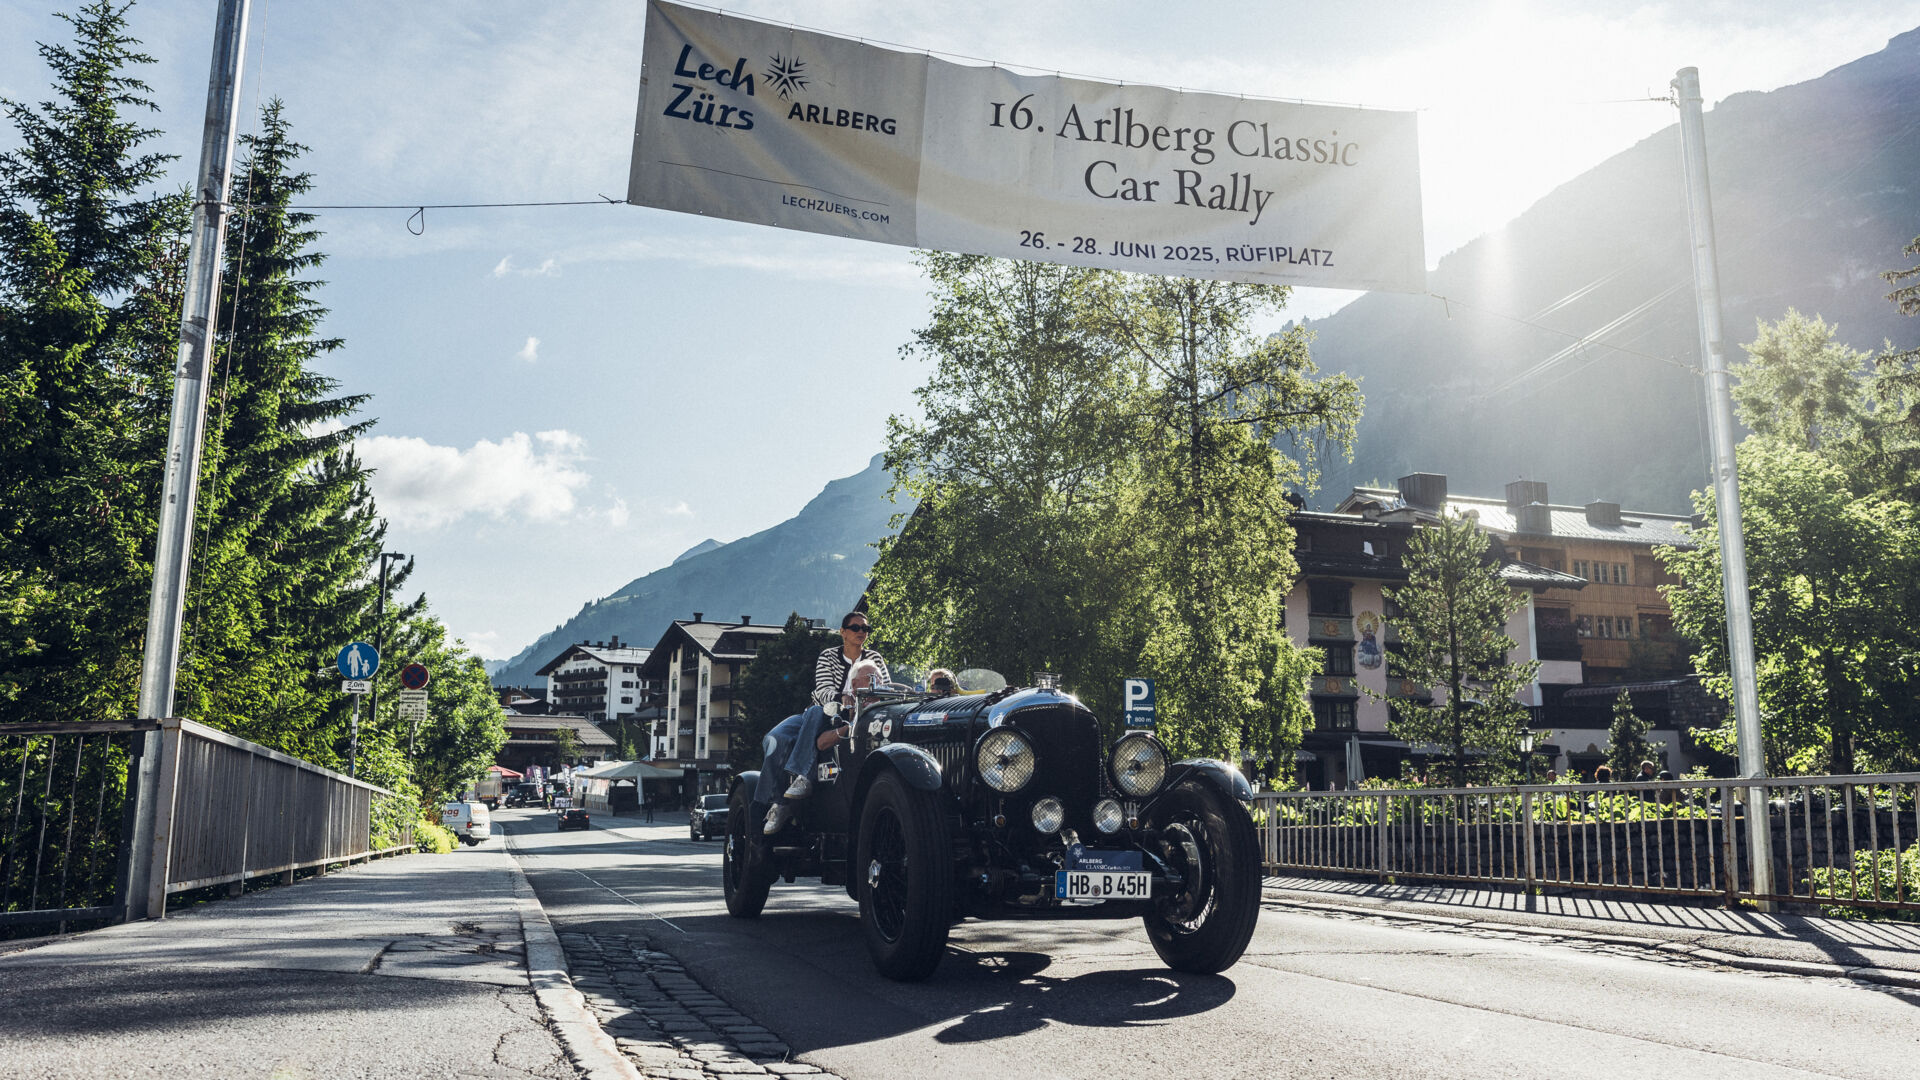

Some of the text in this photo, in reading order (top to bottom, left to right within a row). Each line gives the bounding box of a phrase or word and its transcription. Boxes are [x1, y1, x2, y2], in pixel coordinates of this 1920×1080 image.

[674, 44, 756, 96] Lech
[663, 83, 755, 131] Zürs
[788, 102, 897, 135] ARLBERG
[989, 93, 1359, 167] 16. Arlberg Classic
[782, 195, 890, 225] LECHZUERS.COM
[1084, 160, 1274, 226] Car Rally
[1020, 230, 1051, 250] 26.
[1073, 236, 1102, 256] 28.
[1109, 241, 1156, 260] JUNI
[1163, 245, 1220, 265] 2025,
[1226, 242, 1335, 267] RÜFIPLATZ
[1125, 679, 1149, 711] P
[1069, 875, 1147, 895] HB B 45H
